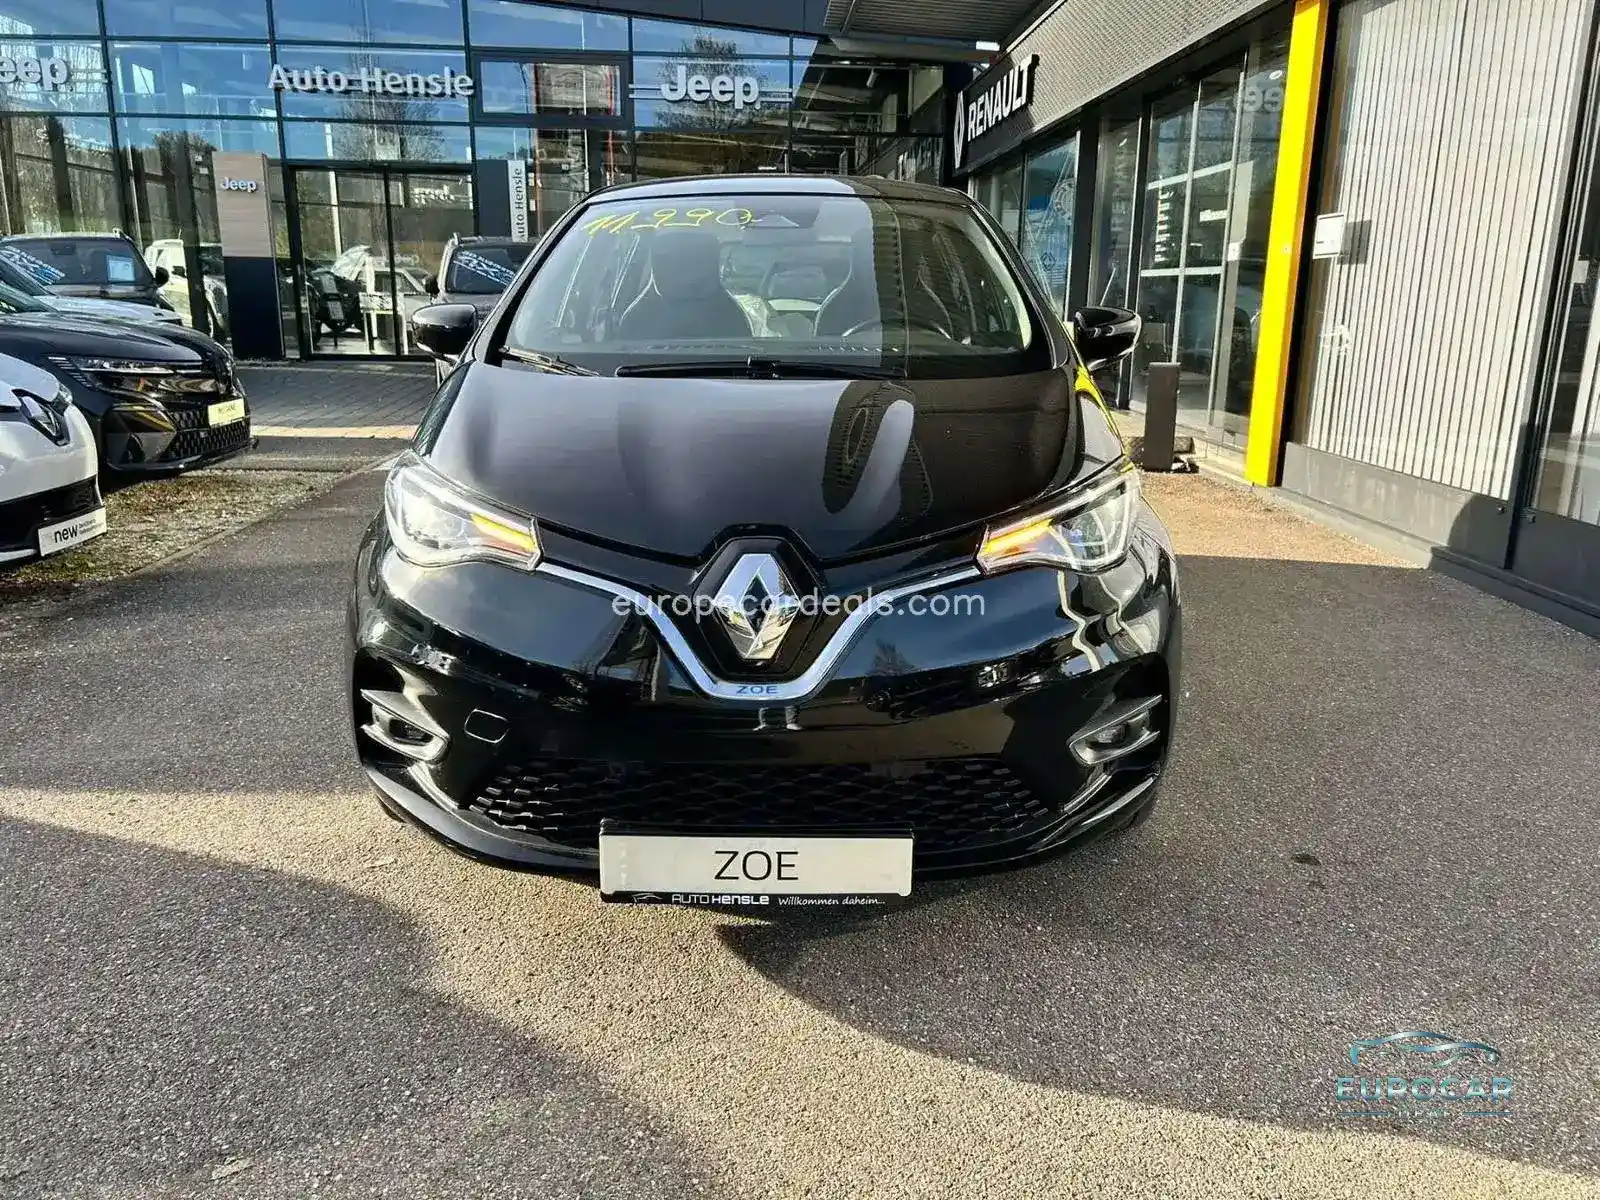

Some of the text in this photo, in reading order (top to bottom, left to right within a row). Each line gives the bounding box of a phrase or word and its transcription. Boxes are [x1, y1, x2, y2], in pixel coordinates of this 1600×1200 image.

[267, 64, 475, 96] Auto Hensle
[660, 64, 761, 110] Jeep
[967, 54, 1032, 142] RENAULT
[219, 176, 257, 193] Jeep
[512, 168, 524, 210] Hensle
[53, 523, 79, 544] new
[736, 685, 779, 695] ZOE
[713, 850, 800, 881] ZOE
[671, 893, 710, 905] AUTO
[778, 896, 839, 906] Willkommen
